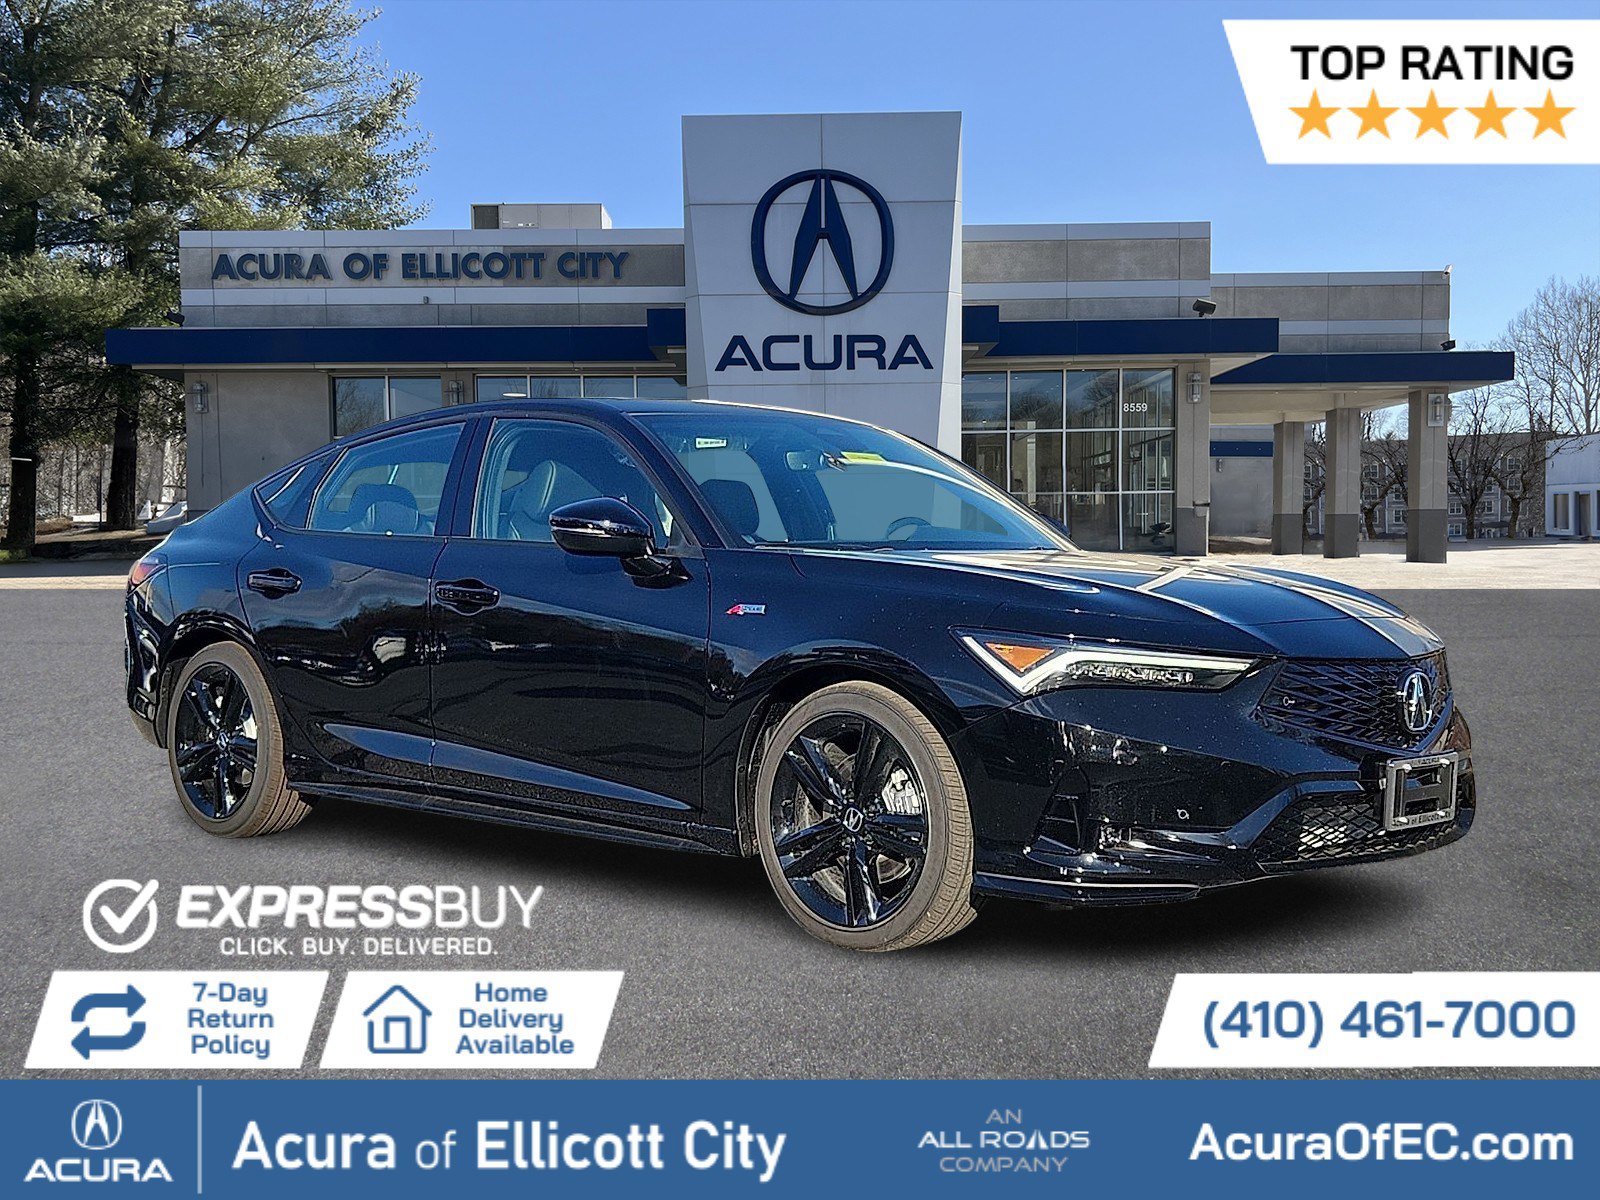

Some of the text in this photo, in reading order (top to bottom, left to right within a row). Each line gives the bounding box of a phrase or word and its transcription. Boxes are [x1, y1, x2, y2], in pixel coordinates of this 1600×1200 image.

[211, 252, 629, 281] ACURA OF ELLICOTT CITY
[714, 333, 934, 372] ACURA
[1122, 403, 1149, 413] 8559
